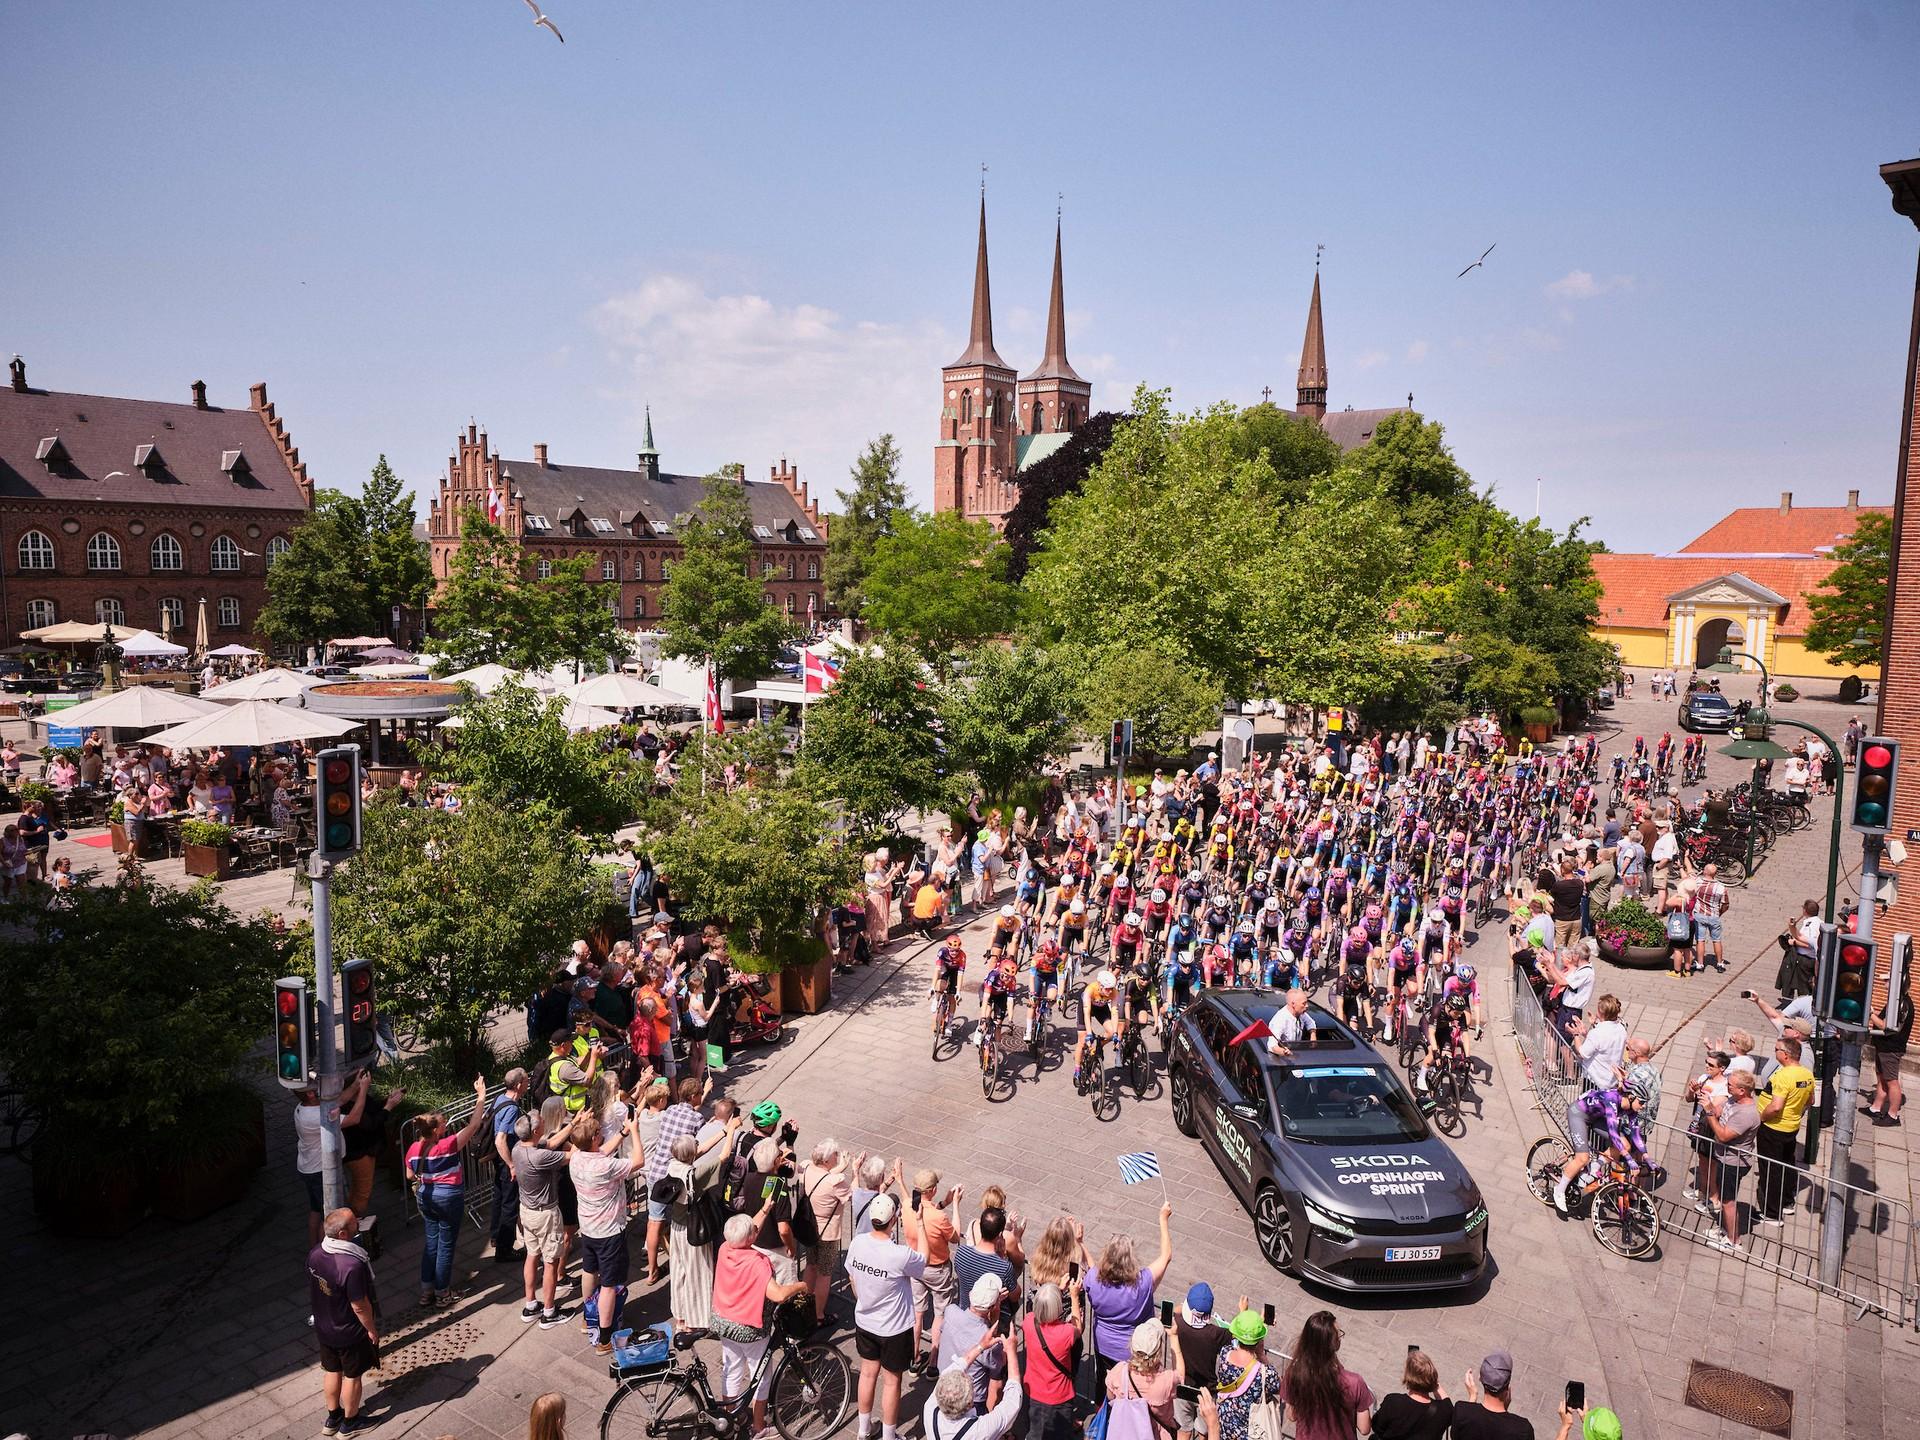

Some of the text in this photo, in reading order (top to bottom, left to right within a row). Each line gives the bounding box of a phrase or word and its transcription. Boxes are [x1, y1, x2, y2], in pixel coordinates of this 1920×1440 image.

[352, 1001, 369, 1021] 27
[1234, 1104, 1258, 1115] SKODA
[1215, 1105, 1252, 1167] SKODA
[1330, 1154, 1431, 1169] SKODA
[1337, 1170, 1446, 1185] COPENHAGEN
[1370, 1182, 1426, 1196] SPRINT
[1464, 1209, 1489, 1233] SKODA
[1393, 1248, 1440, 1260] EJ 30 557
